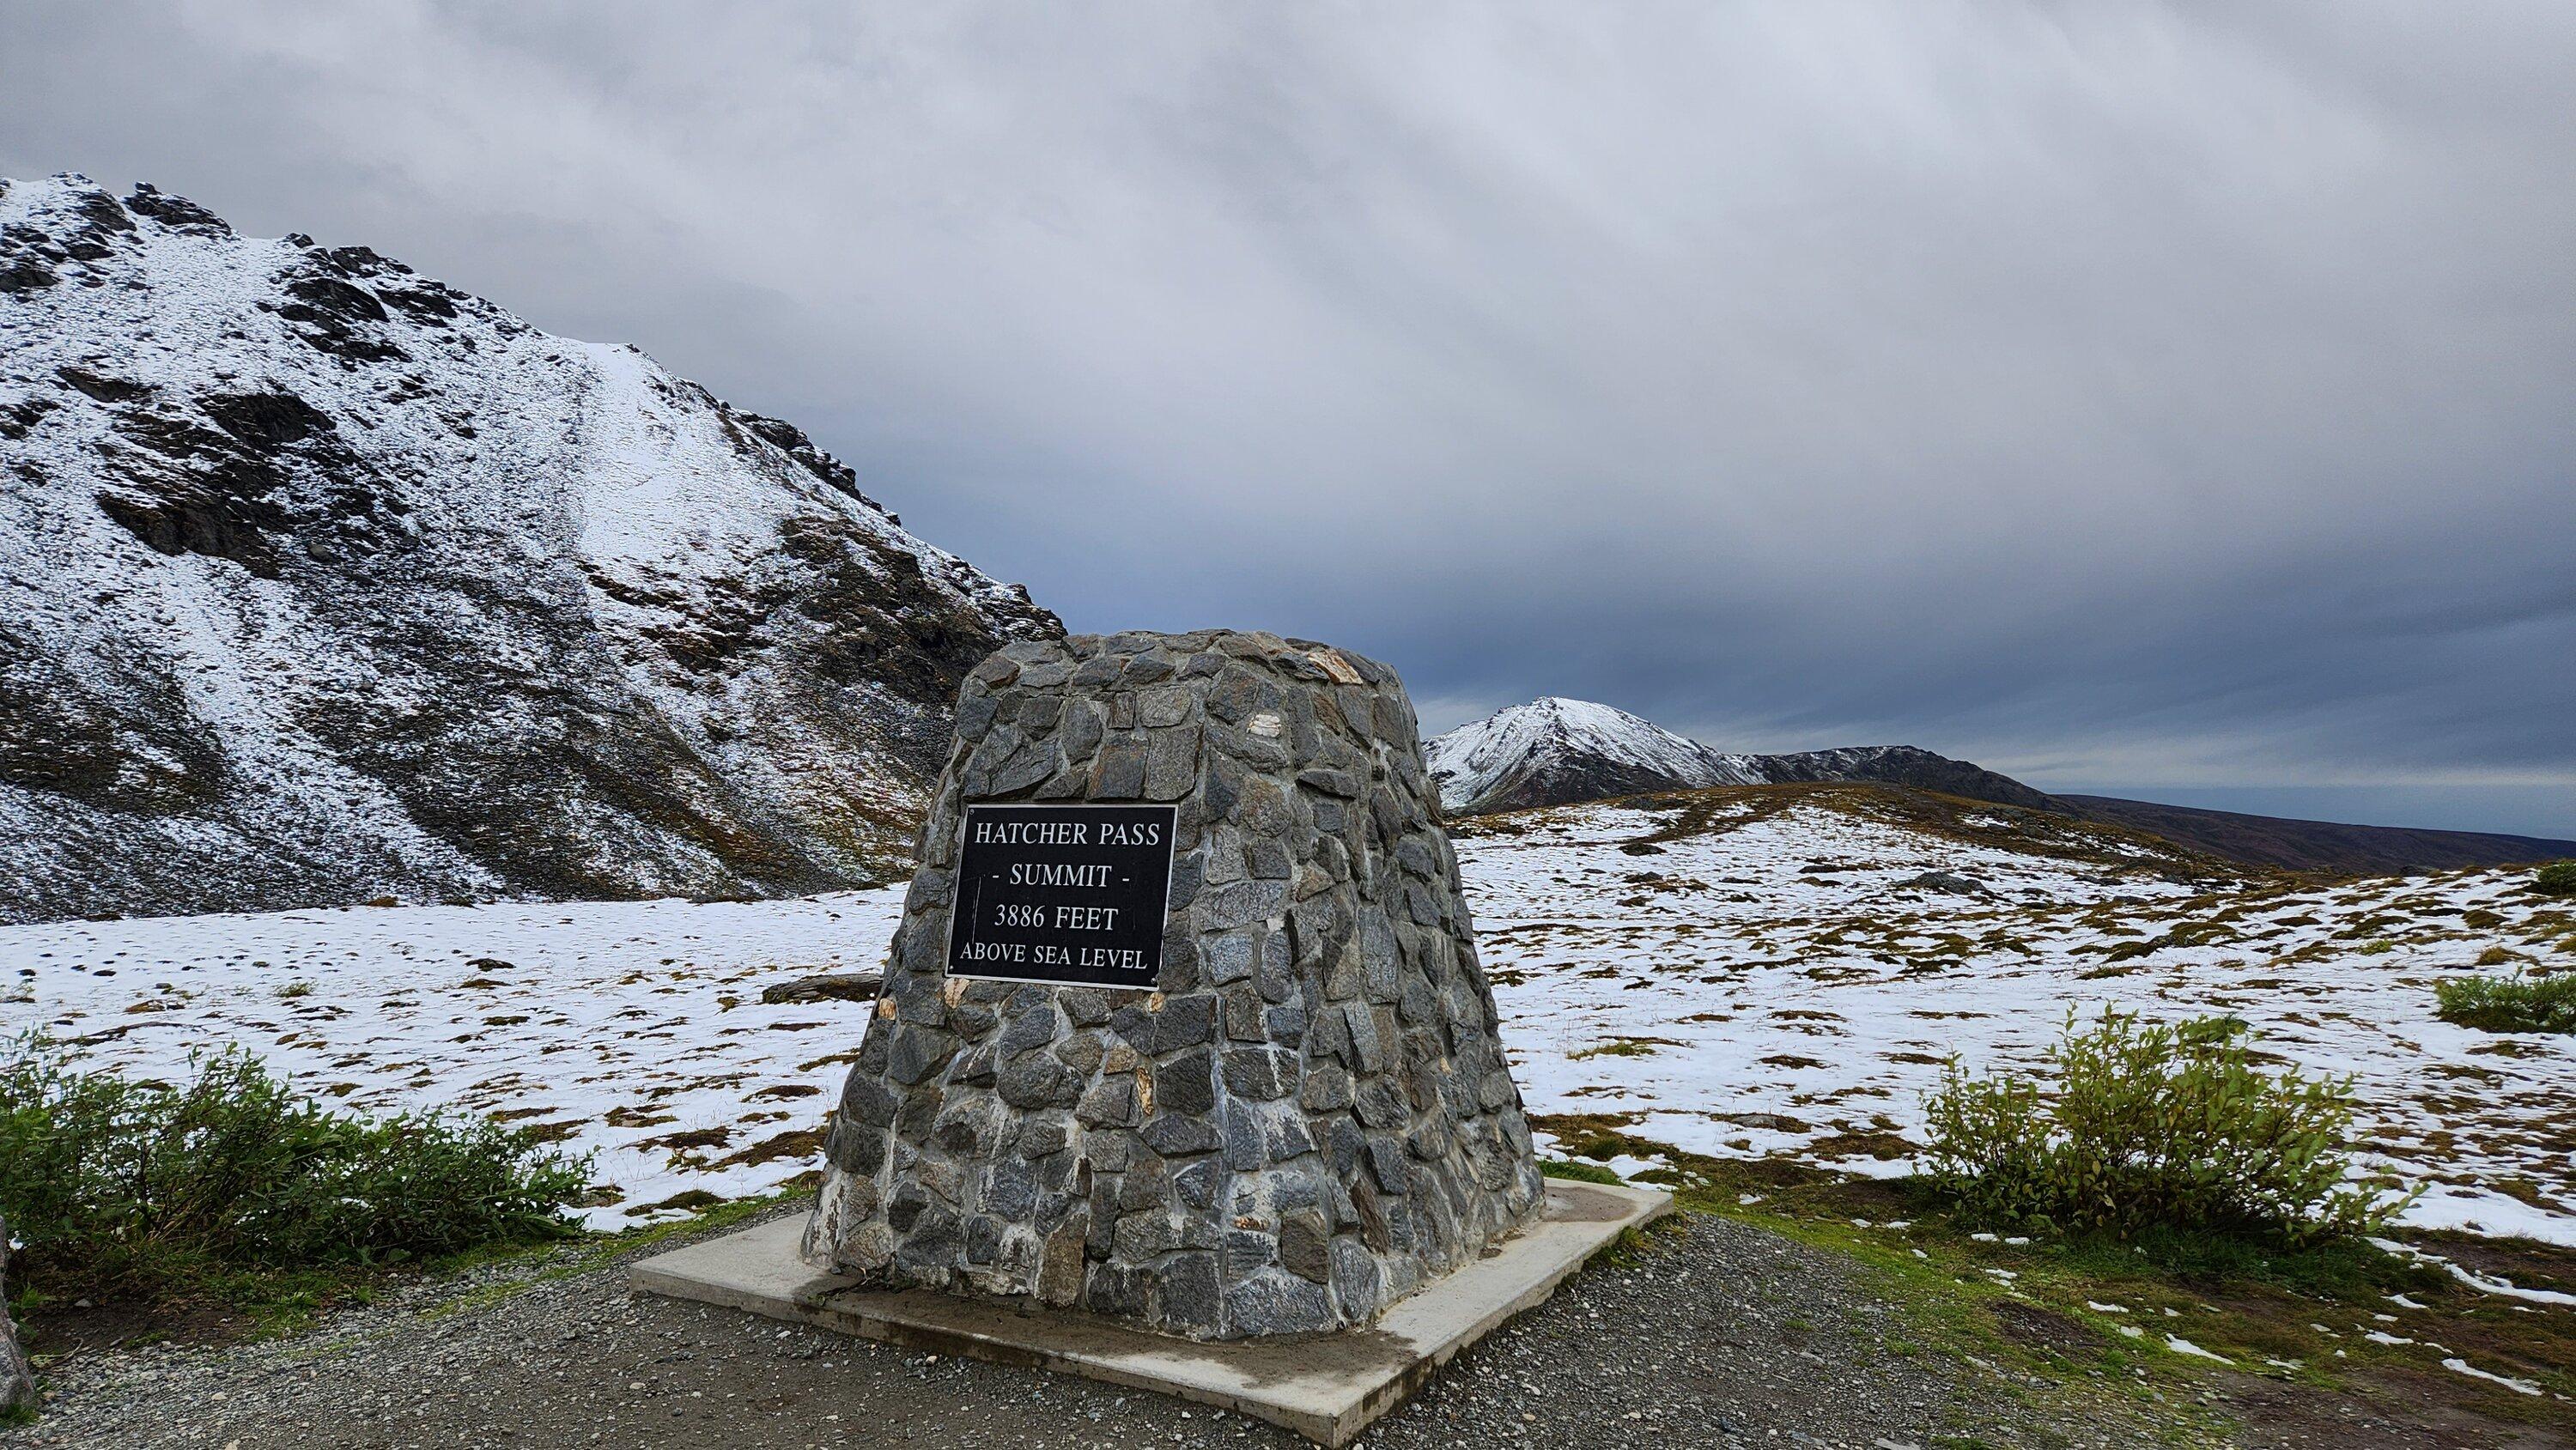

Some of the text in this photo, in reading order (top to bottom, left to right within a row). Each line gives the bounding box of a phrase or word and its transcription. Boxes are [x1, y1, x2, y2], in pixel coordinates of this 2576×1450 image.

[975, 822, 1160, 846] HATCHER PASS
[1010, 863, 1112, 887] SUMMIT
[994, 904, 1118, 931] 3886 FEET
[960, 942, 1148, 969] ABOVE SEA LEVEL
